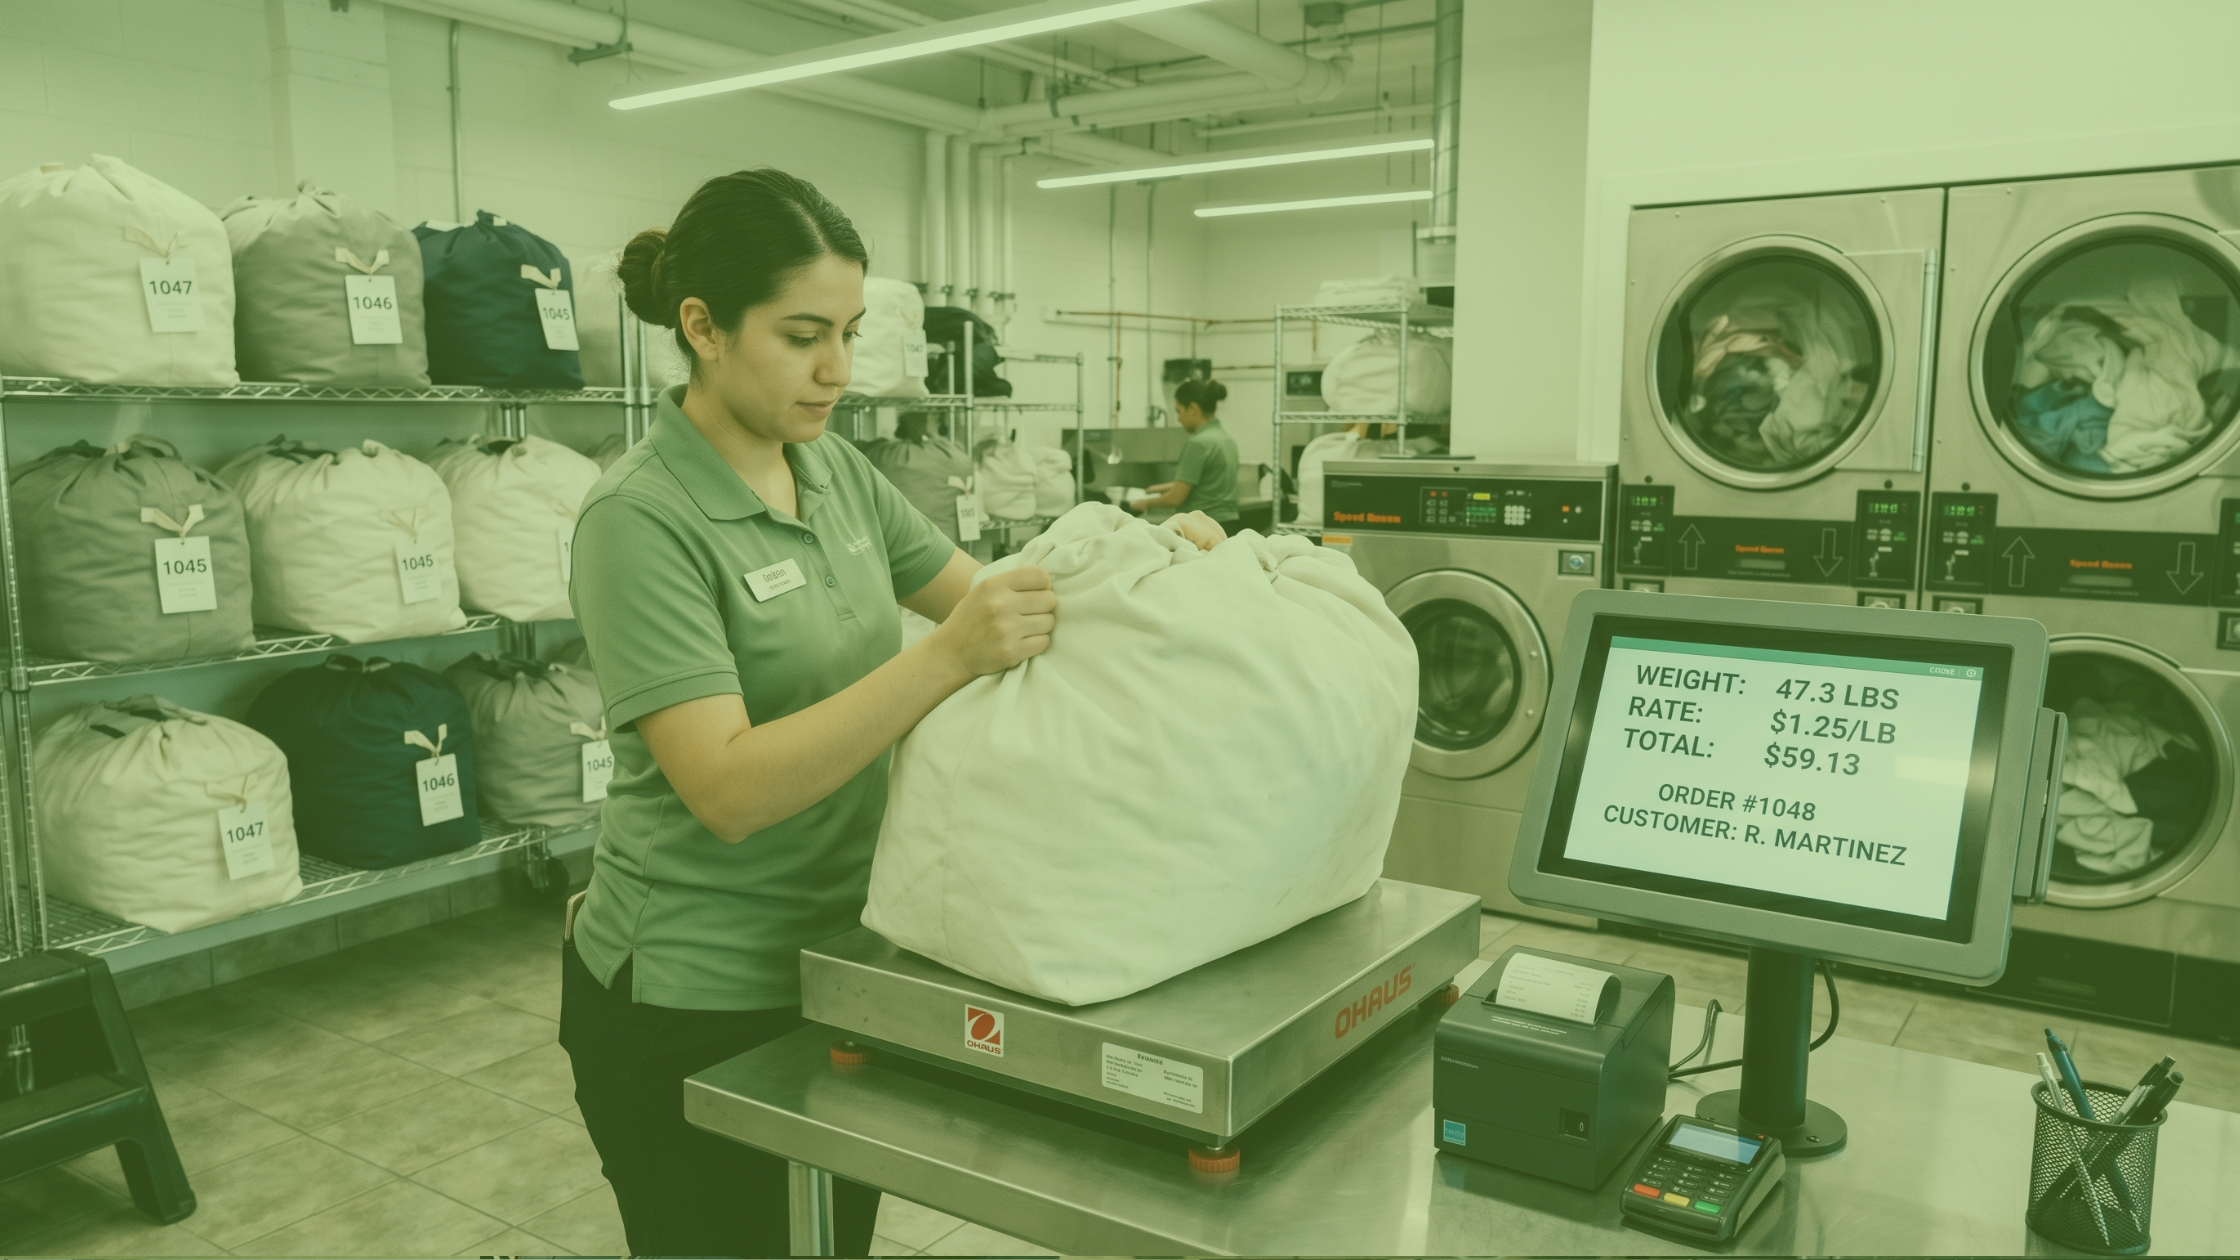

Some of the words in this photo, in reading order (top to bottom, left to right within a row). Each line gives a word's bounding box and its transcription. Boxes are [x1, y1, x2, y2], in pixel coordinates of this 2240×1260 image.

[149, 280, 193, 295] 1047
[352, 295, 393, 311] 1046
[541, 306, 571, 321] 1045
[1333, 510, 1365, 523] Speed
[1366, 512, 1402, 524] Queen
[163, 558, 207, 576] 1045
[402, 554, 434, 571] 1045
[1635, 664, 1747, 697] WEIGHT:
[1775, 678, 1836, 705] 47.3
[1843, 684, 1900, 710] LBS
[1628, 695, 1704, 725] RATE:
[1769, 708, 1897, 745] $1.25/LB
[1623, 727, 1715, 760] TOTAL:
[1763, 742, 1861, 777] $59.13
[586, 756, 613, 773] 1045
[421, 772, 456, 793] 1046
[1658, 783, 1735, 811] ORDER
[1742, 794, 1817, 822] #1048
[226, 821, 264, 844] 1047
[1603, 803, 1738, 841] CUSTOMER:
[1744, 824, 1766, 845] R.
[1774, 828, 1908, 867] MARTINEZ
[1334, 964, 1412, 1040] OHAUS
[966, 1039, 1001, 1055] OHAUS
